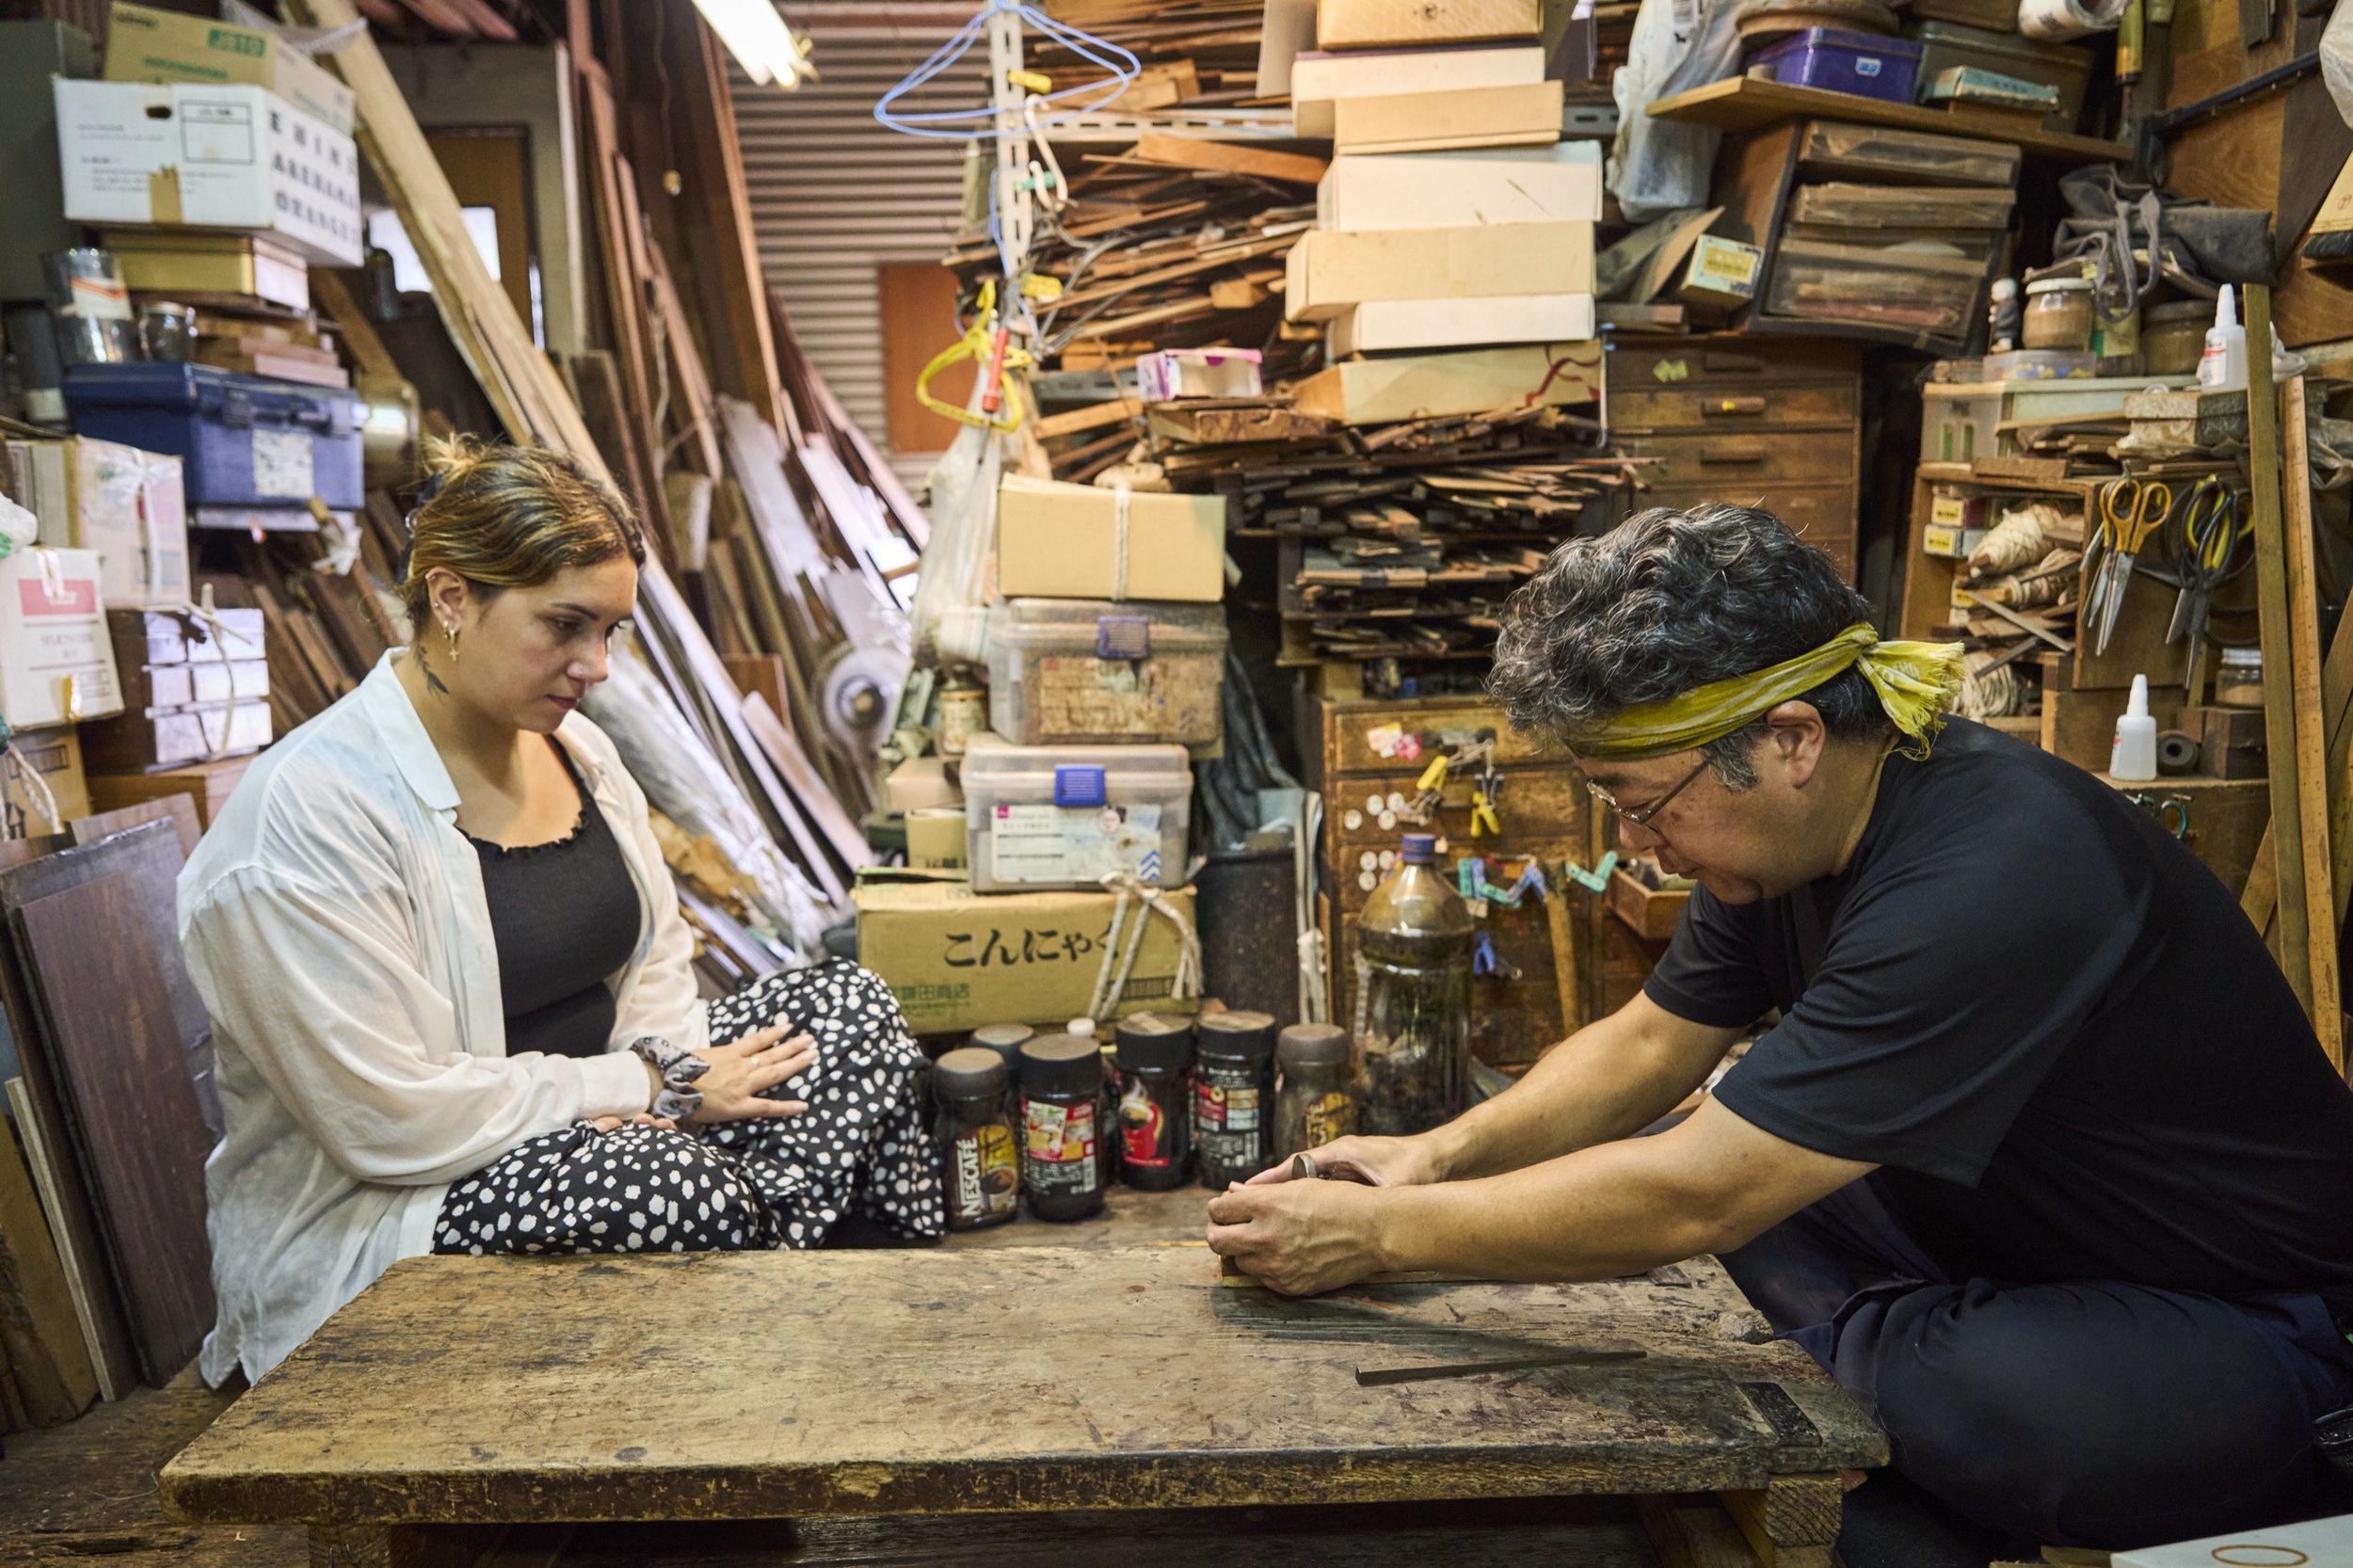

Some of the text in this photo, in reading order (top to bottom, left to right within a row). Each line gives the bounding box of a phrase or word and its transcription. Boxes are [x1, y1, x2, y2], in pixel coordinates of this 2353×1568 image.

[944, 920, 1119, 968] こんにゃく
[955, 1137, 983, 1217] NESCAFÉ
